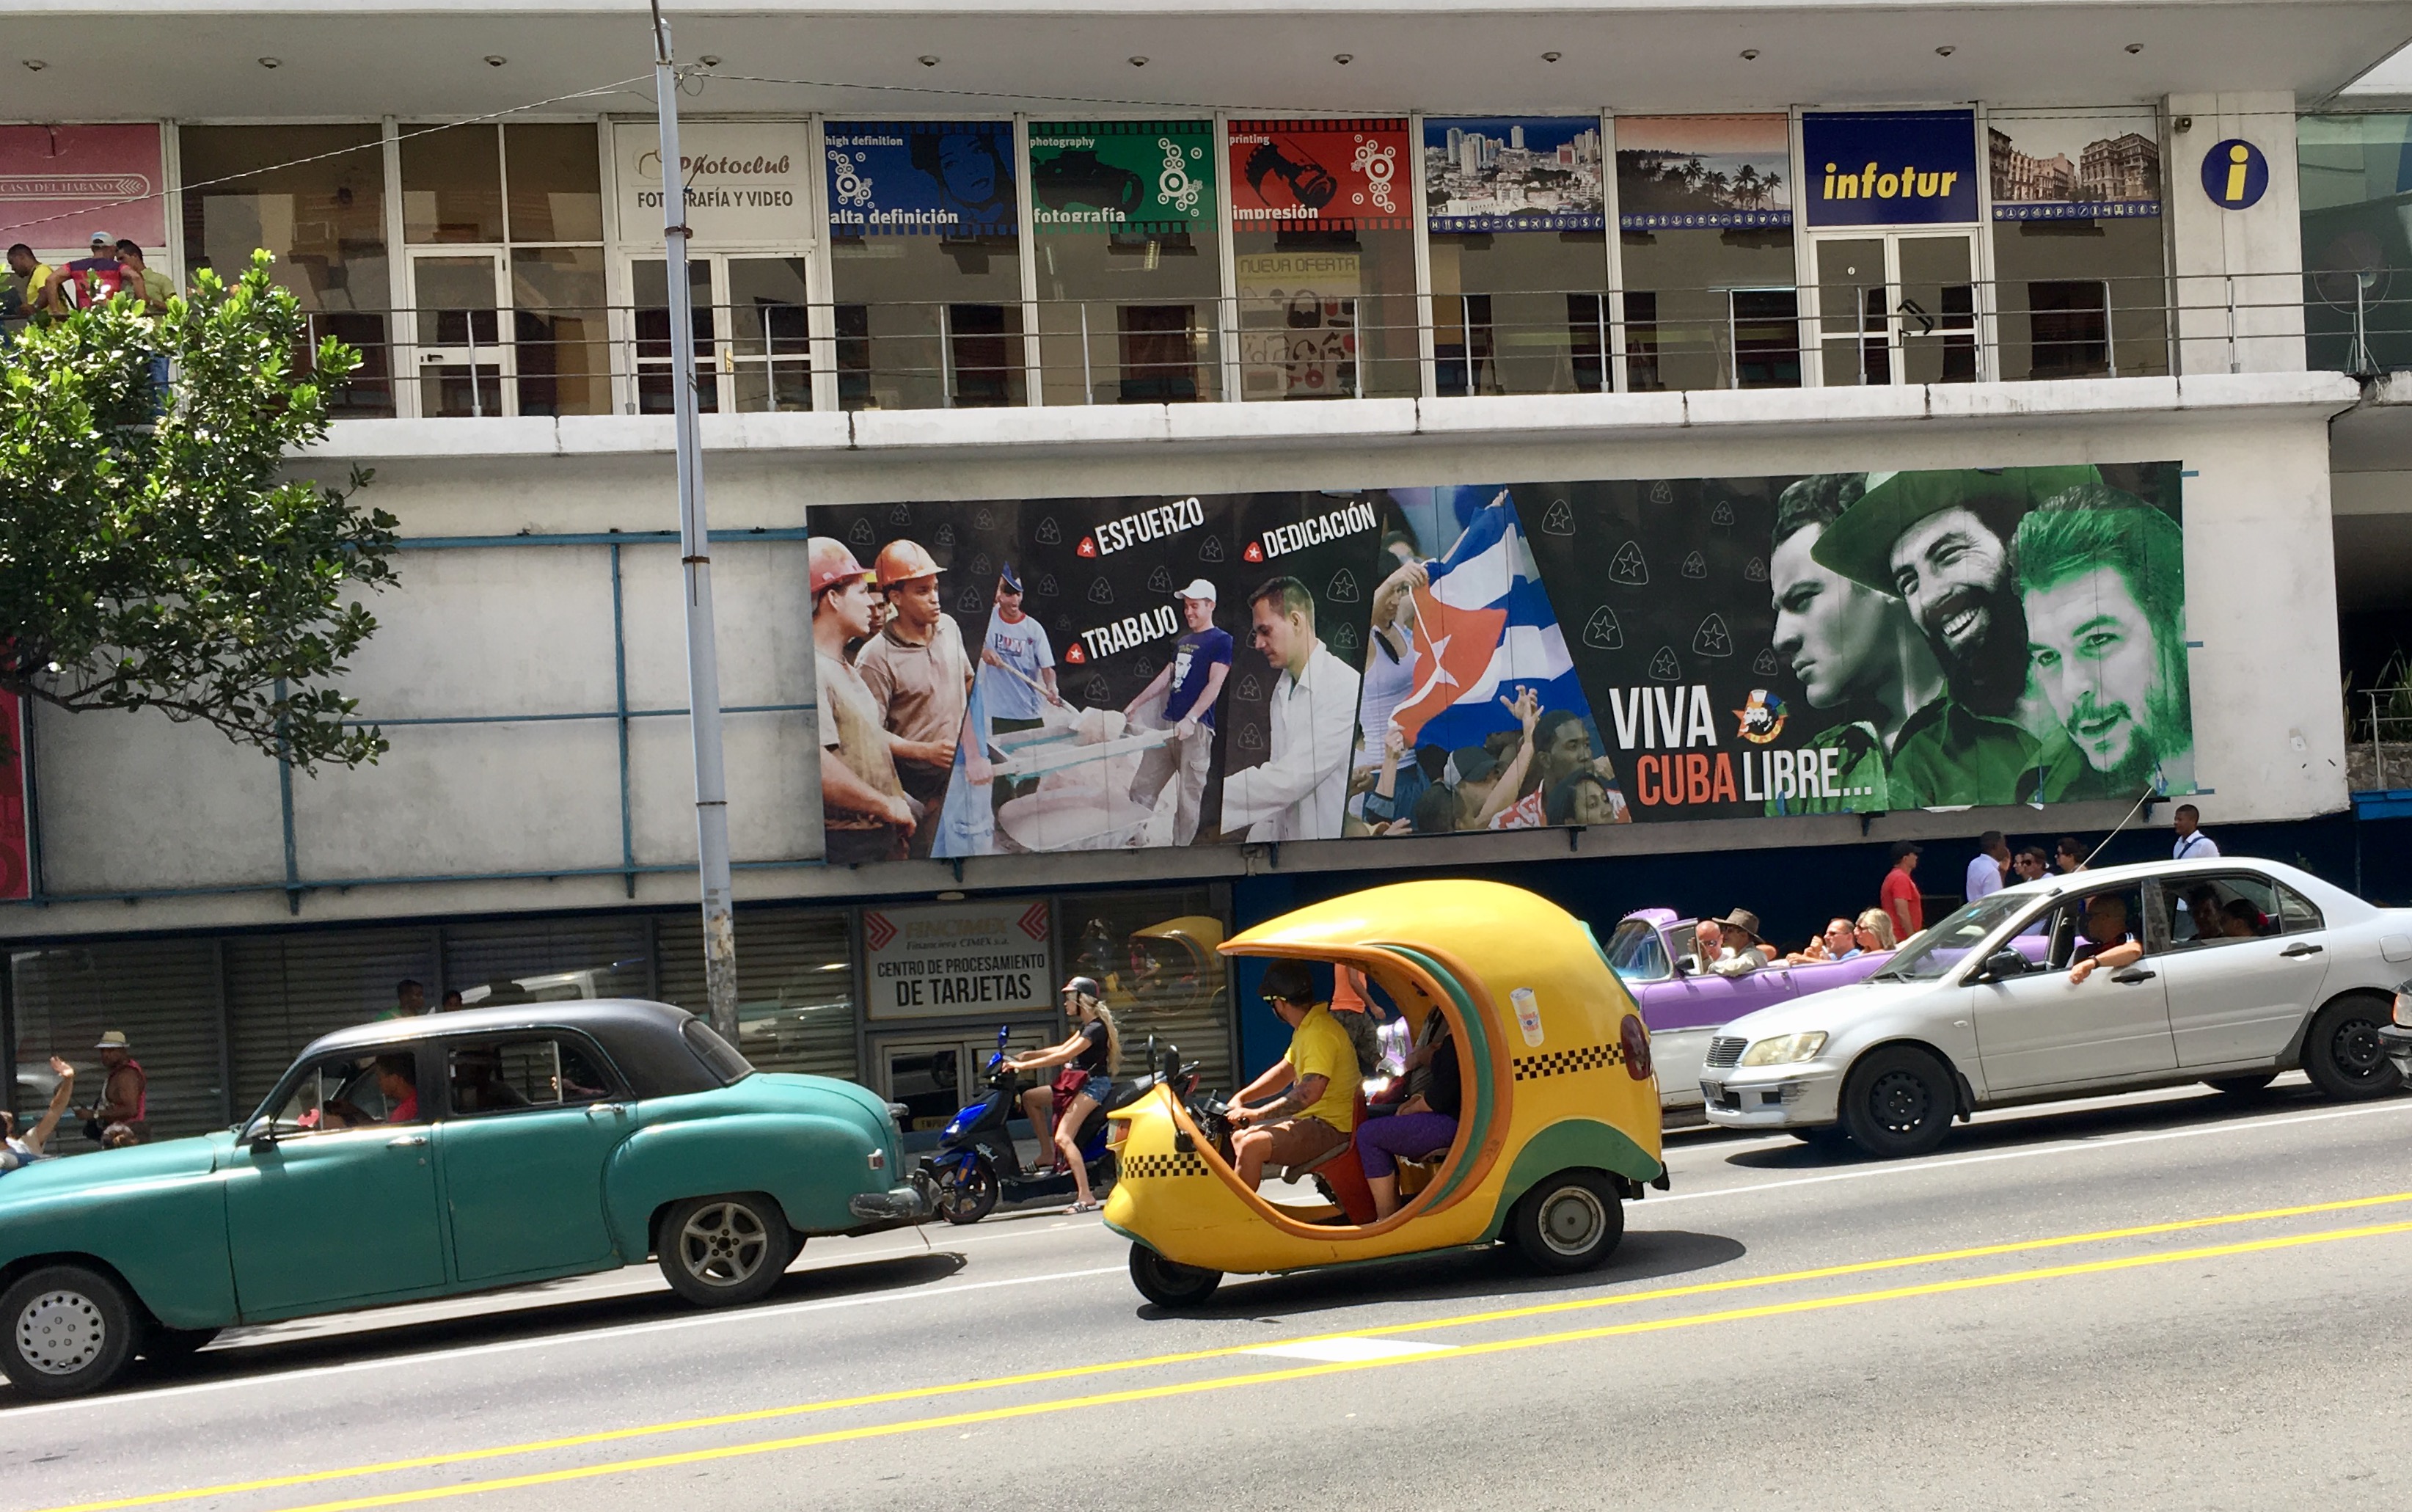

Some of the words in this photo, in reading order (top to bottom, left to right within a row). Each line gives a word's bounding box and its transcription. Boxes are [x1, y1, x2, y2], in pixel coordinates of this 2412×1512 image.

[825, 136, 849, 147] high
[852, 136, 903, 146] definition
[1030, 136, 1094, 148] photography
[1229, 134, 1270, 146] printing
[679, 154, 790, 175] Photoclub
[1, 183, 31, 192] CASA
[34, 183, 59, 192] DEL
[62, 182, 113, 192] HABANO
[1823, 161, 1958, 200] infotur
[637, 187, 731, 208] FOTRAFÍA
[734, 191, 743, 207] Y
[746, 191, 793, 207] VIDEO
[830, 208, 864, 224] alta
[869, 208, 959, 224] definición
[1034, 207, 1126, 223] fotografía
[1232, 203, 1318, 220] impresión
[1240, 258, 1291, 273] NUEVA
[1295, 258, 1356, 272] OFERTA
[1094, 496, 1205, 556] ESFUERZO
[1262, 501, 1377, 560] DEDICACIÓN
[1081, 605, 1179, 660] TRABAJO
[1608, 684, 1717, 750] VIVA
[1636, 753, 1737, 806] CUBA
[1742, 747, 1873, 802] LIBRE...
[905, 917, 1008, 938] FINCIMEX
[906, 938, 957, 951] Financiera
[959, 937, 992, 948] CIMEX
[877, 960, 924, 977] CENTRO
[927, 959, 943, 974] DE
[946, 953, 1045, 974] PROCESAMIENTO
[896, 979, 924, 1007] DE
[929, 974, 1032, 1005] TARJETAS
